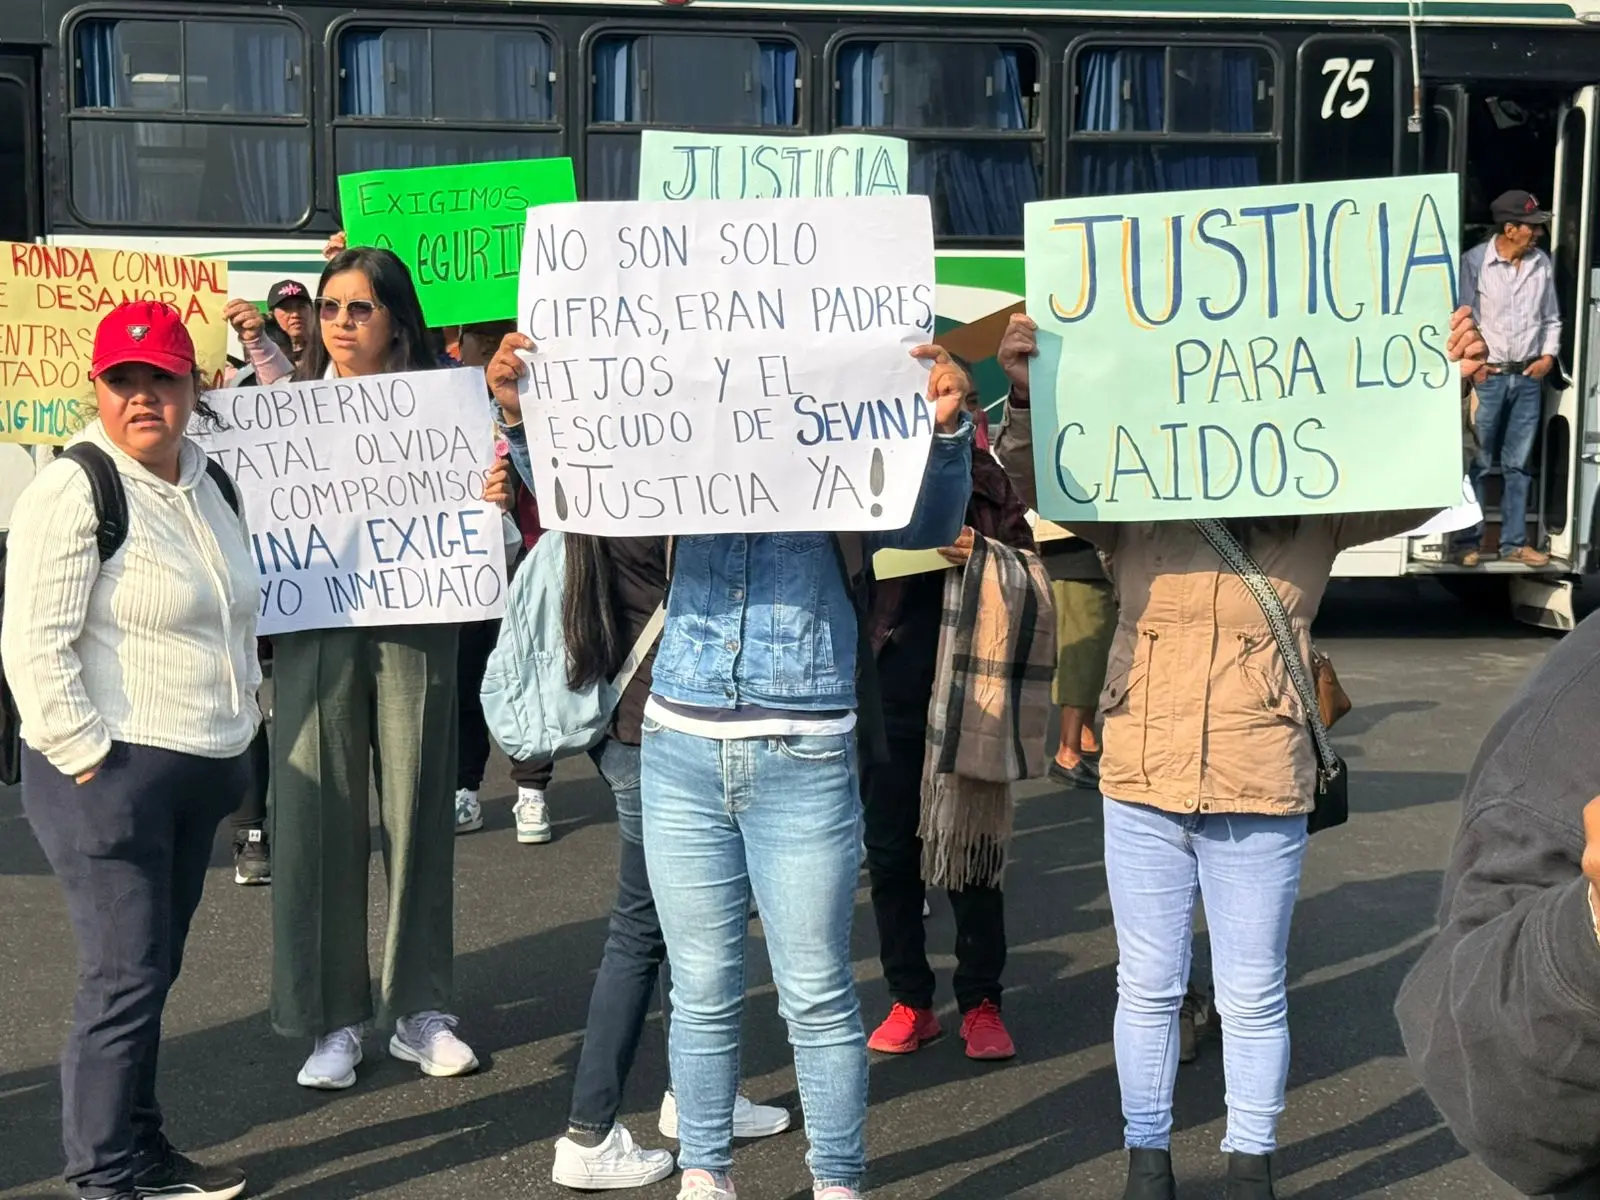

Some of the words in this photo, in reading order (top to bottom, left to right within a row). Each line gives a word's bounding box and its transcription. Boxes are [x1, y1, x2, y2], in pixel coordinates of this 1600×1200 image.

[1320, 57, 1375, 119] 75
[358, 181, 529, 216] EXIGIMOS
[663, 144, 901, 200] JUSTICIA
[11, 243, 98, 284] RONDA
[112, 250, 228, 294] COMUNAL
[374, 222, 527, 285] EGURI
[536, 223, 588, 276] NO
[617, 224, 689, 270] SON
[719, 221, 818, 267] SOLO
[1048, 193, 1460, 330] JUSTICIA
[0, 323, 95, 361] NTRAS
[529, 294, 670, 346] CIFRAS,
[675, 287, 786, 333] ERAN
[811, 284, 933, 335] PADRES,
[530, 355, 674, 403] HIJOS
[713, 356, 731, 403] Y
[758, 355, 805, 399] EL
[1174, 334, 1327, 405] PARA
[1353, 324, 1450, 390] LOS
[0, 397, 86, 438] IGIMOS
[231, 378, 416, 431] GOBIERNO
[547, 410, 693, 454] ESCUDO
[732, 407, 776, 444] DE
[793, 392, 932, 447] SEVINA
[355, 425, 478, 466] OLVIDA
[1053, 417, 1341, 504] CAIDOS
[550, 456, 780, 522] ¡JUSTICIA
[807, 447, 886, 518] YA!
[252, 523, 340, 576] INA
[366, 509, 489, 564] EXIGE
[324, 563, 501, 614] INMEDIATO
